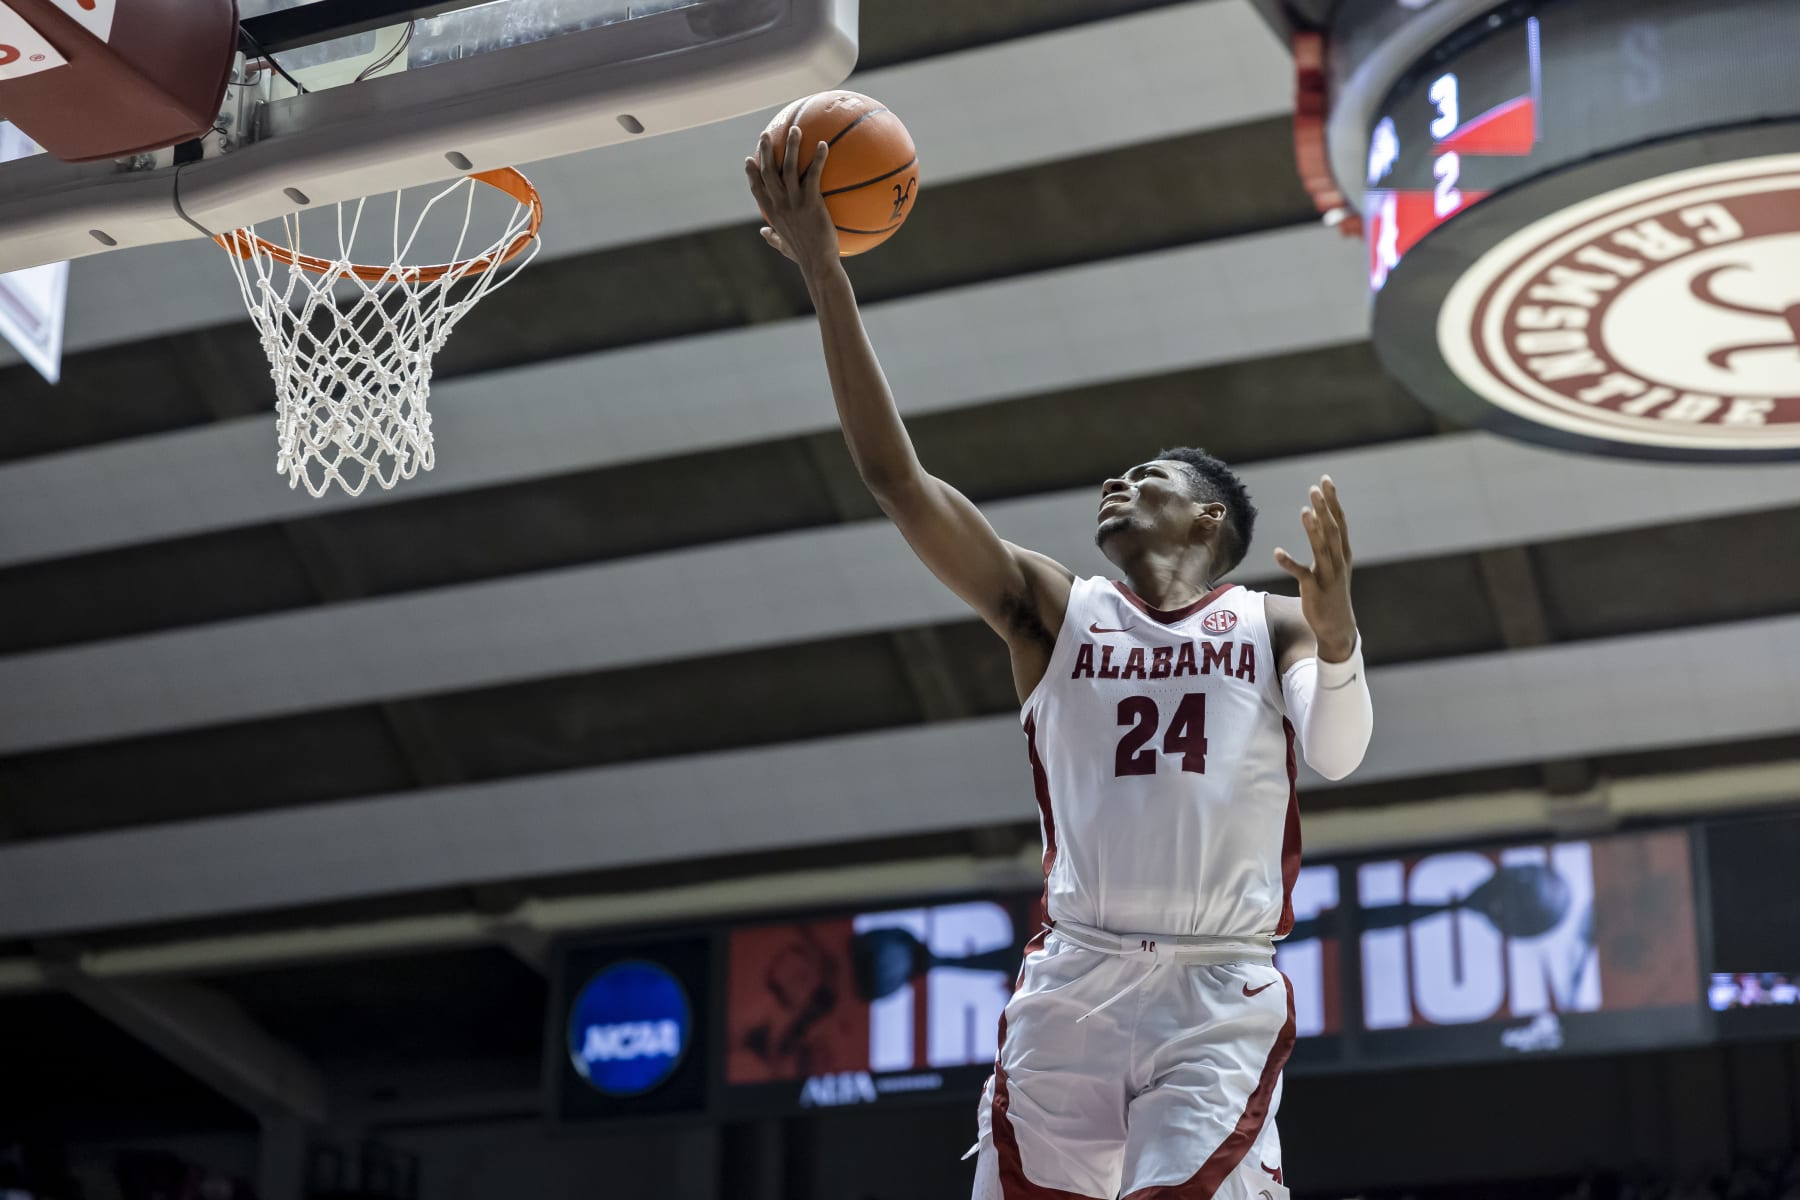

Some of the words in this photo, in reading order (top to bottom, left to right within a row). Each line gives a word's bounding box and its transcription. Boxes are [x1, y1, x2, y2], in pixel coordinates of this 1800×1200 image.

[1429, 73, 1459, 139] 3
[1433, 151, 1462, 219] 2
[1515, 203, 1744, 381] CRIMSON
[1577, 371, 1776, 426] TIDE
[1205, 611, 1237, 631] SEC
[1071, 641, 1257, 684] ALABAMA
[1114, 692, 1208, 778] 24
[584, 1020, 680, 1062] NCAA
